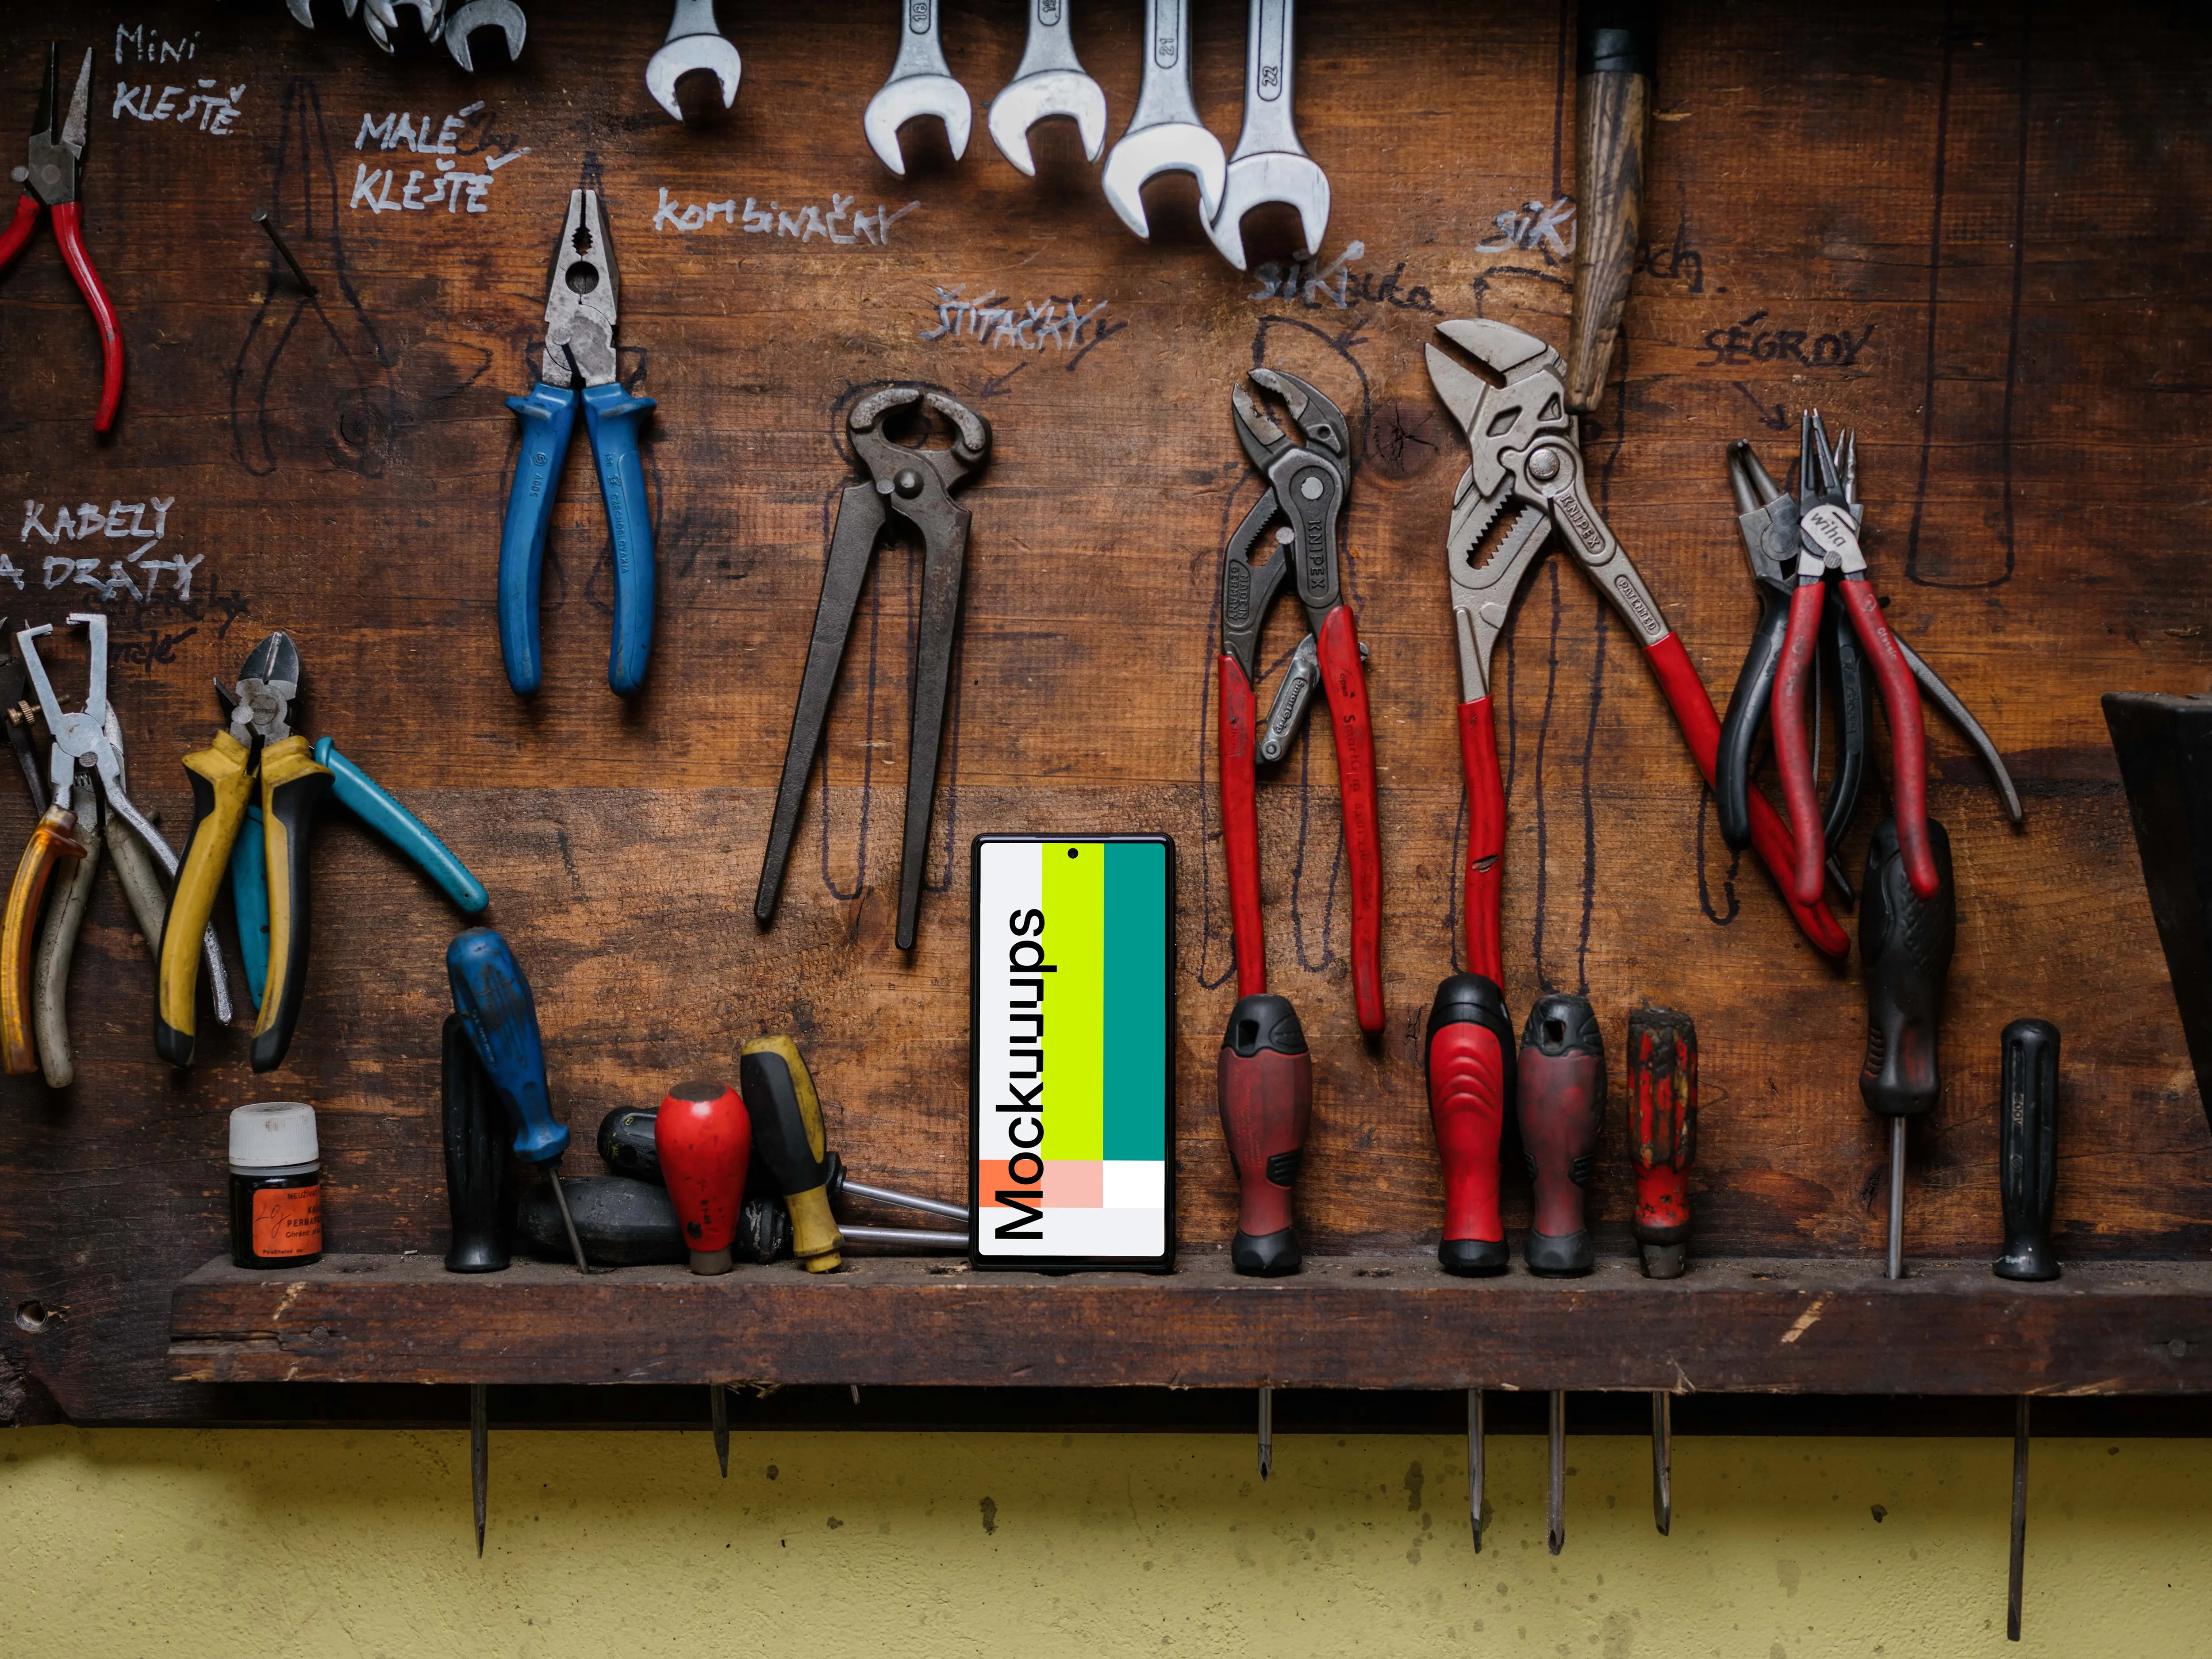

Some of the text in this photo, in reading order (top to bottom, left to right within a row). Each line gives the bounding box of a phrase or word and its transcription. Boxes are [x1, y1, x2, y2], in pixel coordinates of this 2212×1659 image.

[912, 3, 927, 22] 18
[1158, 38, 1175, 56] 21
[1261, 65, 1278, 87] 22
[355, 100, 485, 154] MALÉ
[20, 496, 175, 544] KABELY
[611, 491, 629, 574] CZECHOSLOVAKIA
[1560, 494, 1601, 549] KNIPEX
[1810, 511, 1847, 548] wiha
[1307, 519, 1325, 590] KNIPEX
[1228, 566, 1240, 622] GERMANY
[1238, 574, 1249, 619] MADE IN
[1619, 579, 1657, 632] PATENTED
[1275, 680, 1306, 734] SmartGrip
[1339, 673, 1349, 698] open
[995, 908, 1057, 1240] Mockuuups
[2012, 1094, 2024, 1127] 500V
